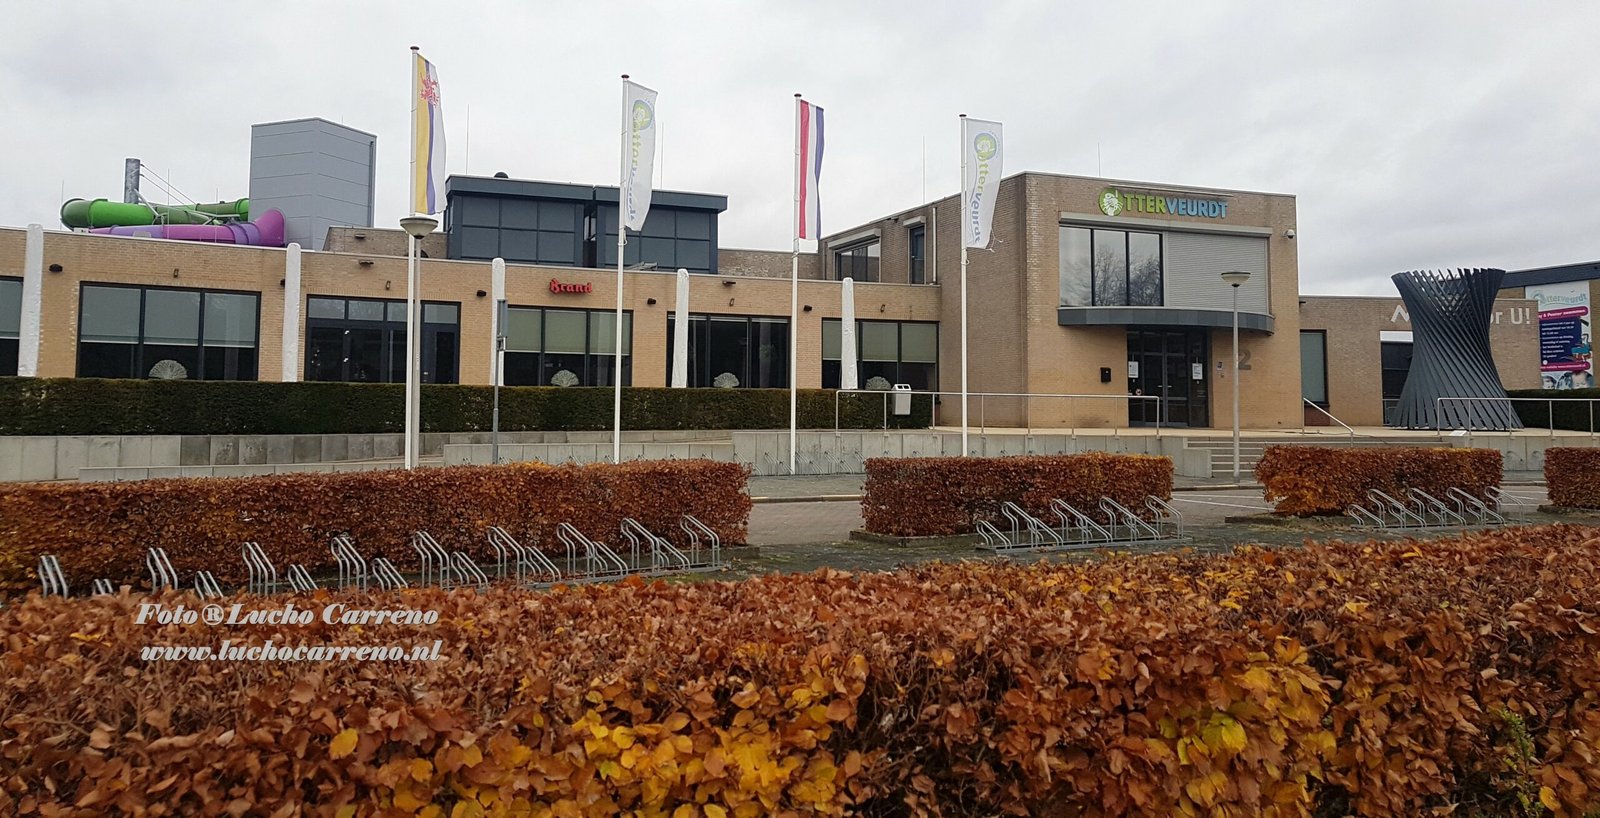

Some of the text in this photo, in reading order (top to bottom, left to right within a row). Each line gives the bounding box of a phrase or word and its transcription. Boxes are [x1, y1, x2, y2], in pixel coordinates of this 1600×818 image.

[549, 277, 593, 294] Brand
[1510, 307, 1531, 325] U!
[1238, 350, 1251, 370] 2
